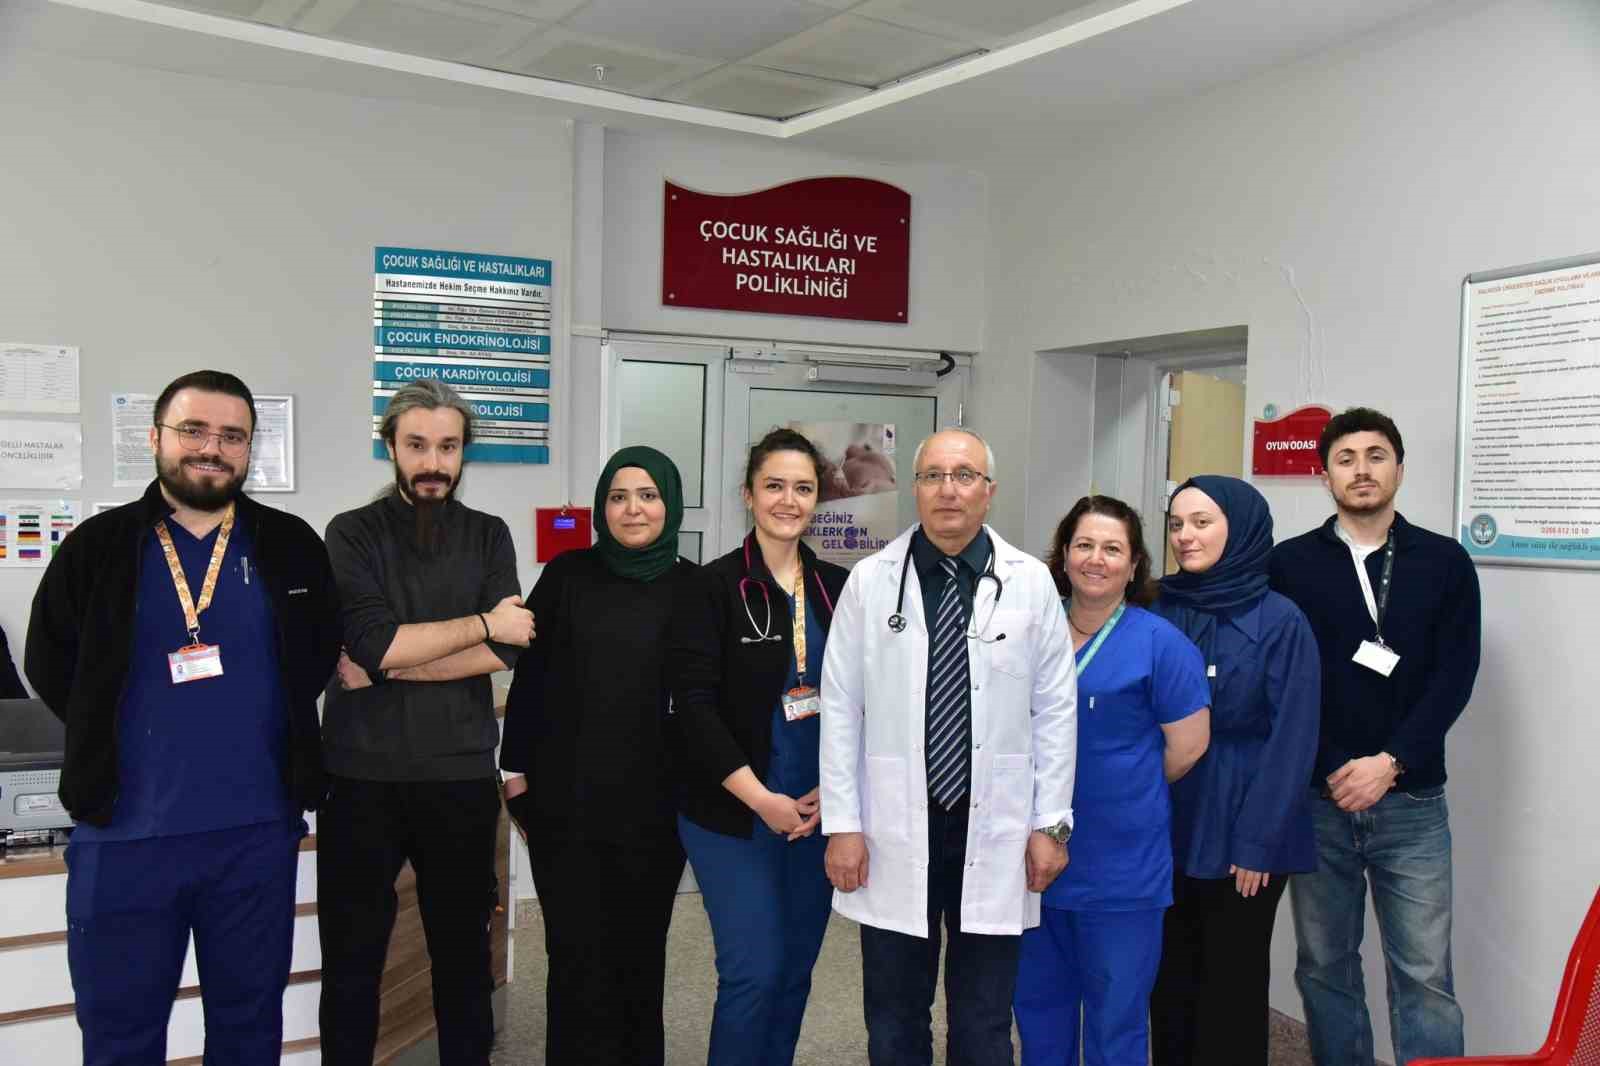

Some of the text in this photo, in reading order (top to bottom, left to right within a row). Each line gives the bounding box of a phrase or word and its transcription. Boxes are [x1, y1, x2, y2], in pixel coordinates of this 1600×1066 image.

[700, 220, 878, 253] ÇOCUK SAĞLIĞI VE
[383, 254, 545, 278] ÇOCUK SAĞLIĞI VE HASTALIKLARI
[722, 248, 856, 275] HASTALIKLARI
[385, 278, 437, 290] Hastanemizde
[439, 281, 462, 291] Hekim
[464, 283, 487, 294] Seçme
[490, 284, 519, 296] Hakkınız
[736, 273, 848, 299] POLİKLİNİĞİ
[387, 331, 541, 350] ÇOCUK ENDOKRİNOLOJİSİ
[395, 366, 531, 383] ÇOCUK KARDİYOLOJİSİ
[471, 403, 523, 417] ROLOJİSİ
[1266, 440, 1317, 451] OYUN ODASI
